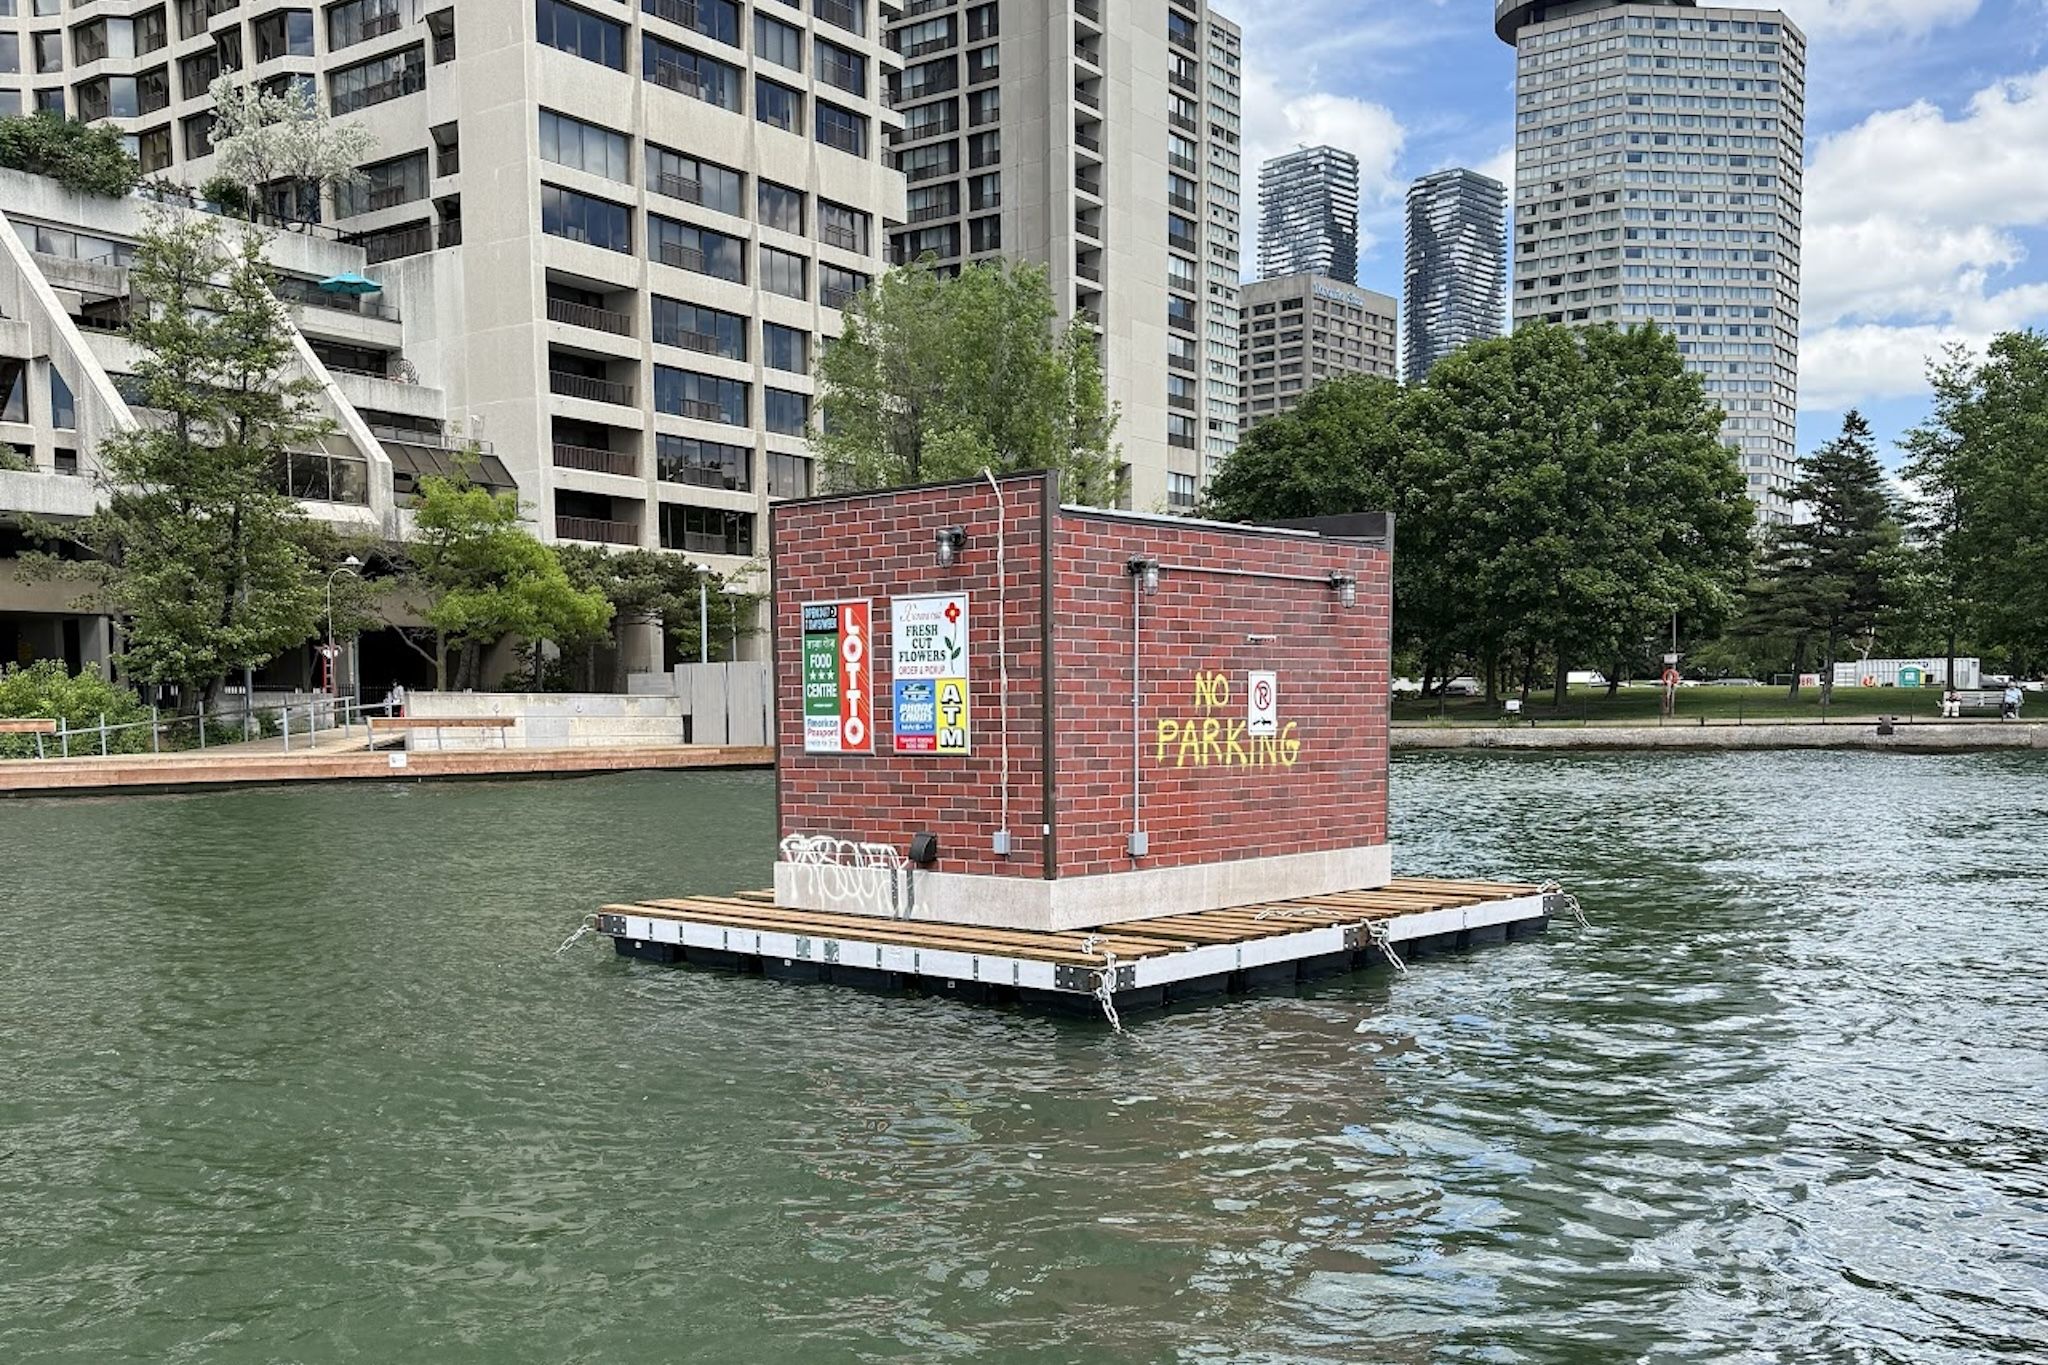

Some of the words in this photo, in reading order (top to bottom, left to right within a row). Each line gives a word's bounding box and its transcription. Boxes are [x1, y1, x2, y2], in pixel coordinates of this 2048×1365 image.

[906, 624, 938, 637] FRESH
[912, 637, 933, 649] CUT
[809, 653, 832, 669] FOOD
[899, 650, 946, 662] FLOWERS
[842, 607, 865, 746] LOTTO
[899, 665, 919, 675] ORDER
[807, 682, 838, 698] CENTRE
[1194, 671, 1230, 711] NO
[941, 684, 965, 747] ATM
[1156, 717, 1301, 769] PARKING
